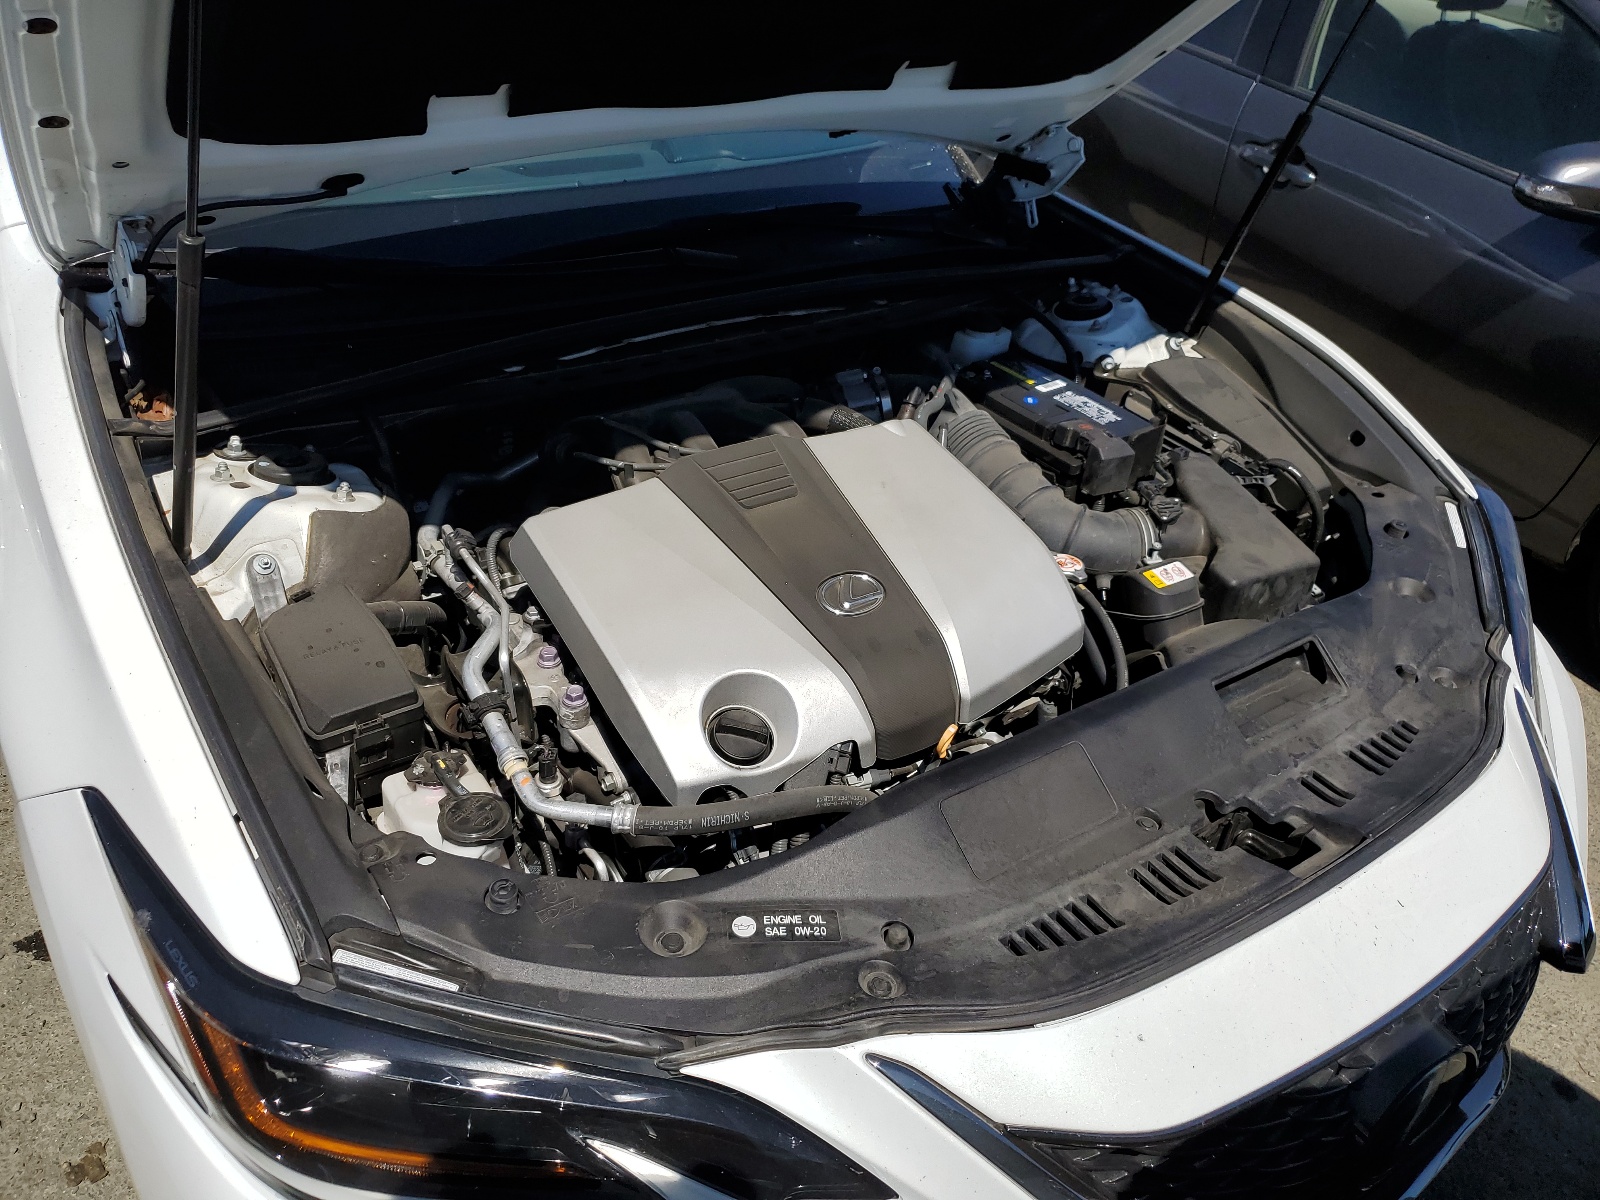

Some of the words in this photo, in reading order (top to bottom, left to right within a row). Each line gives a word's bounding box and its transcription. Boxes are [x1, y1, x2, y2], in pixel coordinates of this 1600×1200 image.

[763, 914, 802, 925] ENGINE
[808, 914, 827, 924] OIL
[765, 926, 787, 936] SAE
[794, 926, 827, 936] 0W-20
[165, 939, 199, 988] LEXUS
